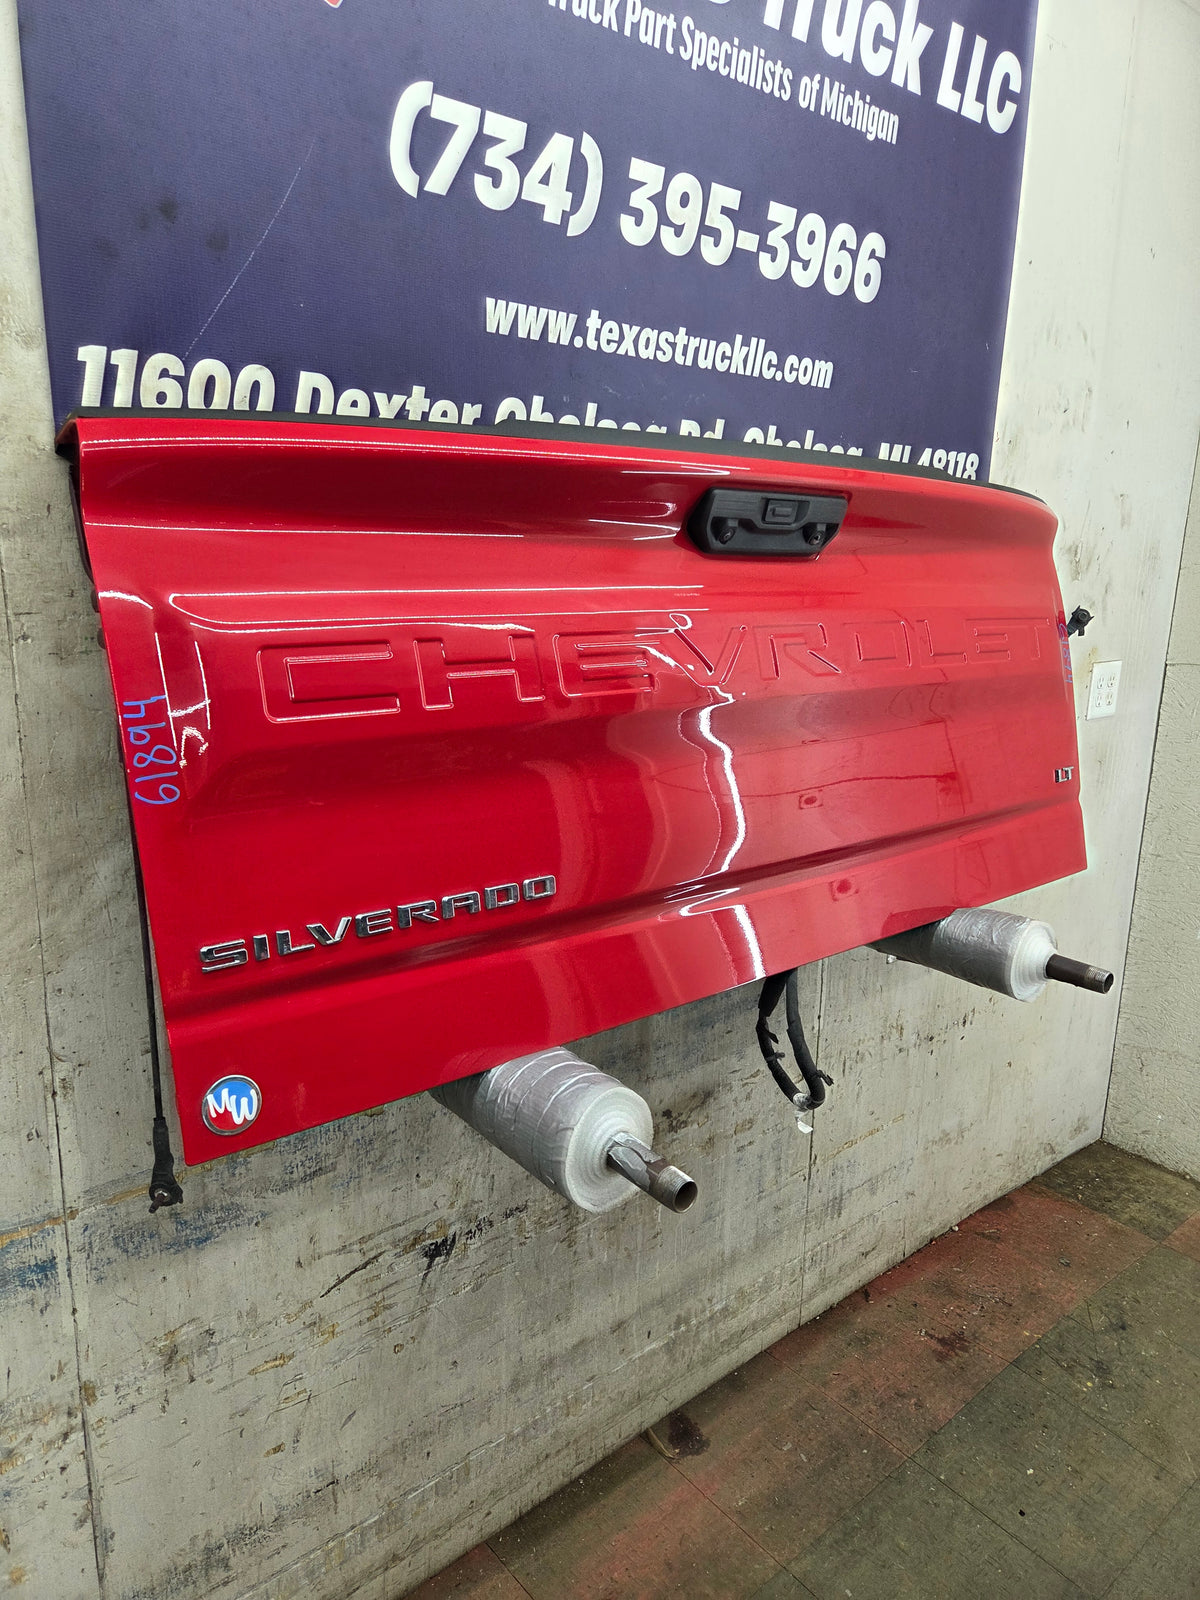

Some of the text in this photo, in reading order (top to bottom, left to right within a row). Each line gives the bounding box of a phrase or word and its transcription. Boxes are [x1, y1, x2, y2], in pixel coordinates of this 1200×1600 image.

[548, 0, 899, 145] uck Part Specialists of Michigan
[936, 21, 1022, 134] LLC
[389, 80, 887, 304] (734) 395-3966
[77, 344, 276, 412] 11600
[485, 297, 834, 389] www.texastruckllc.com
[256, 615, 1051, 724] CHEVROLET
[123, 694, 181, 805] 61894
[1054, 765, 1075, 783] LT
[200, 873, 557, 973] SILVERADO
